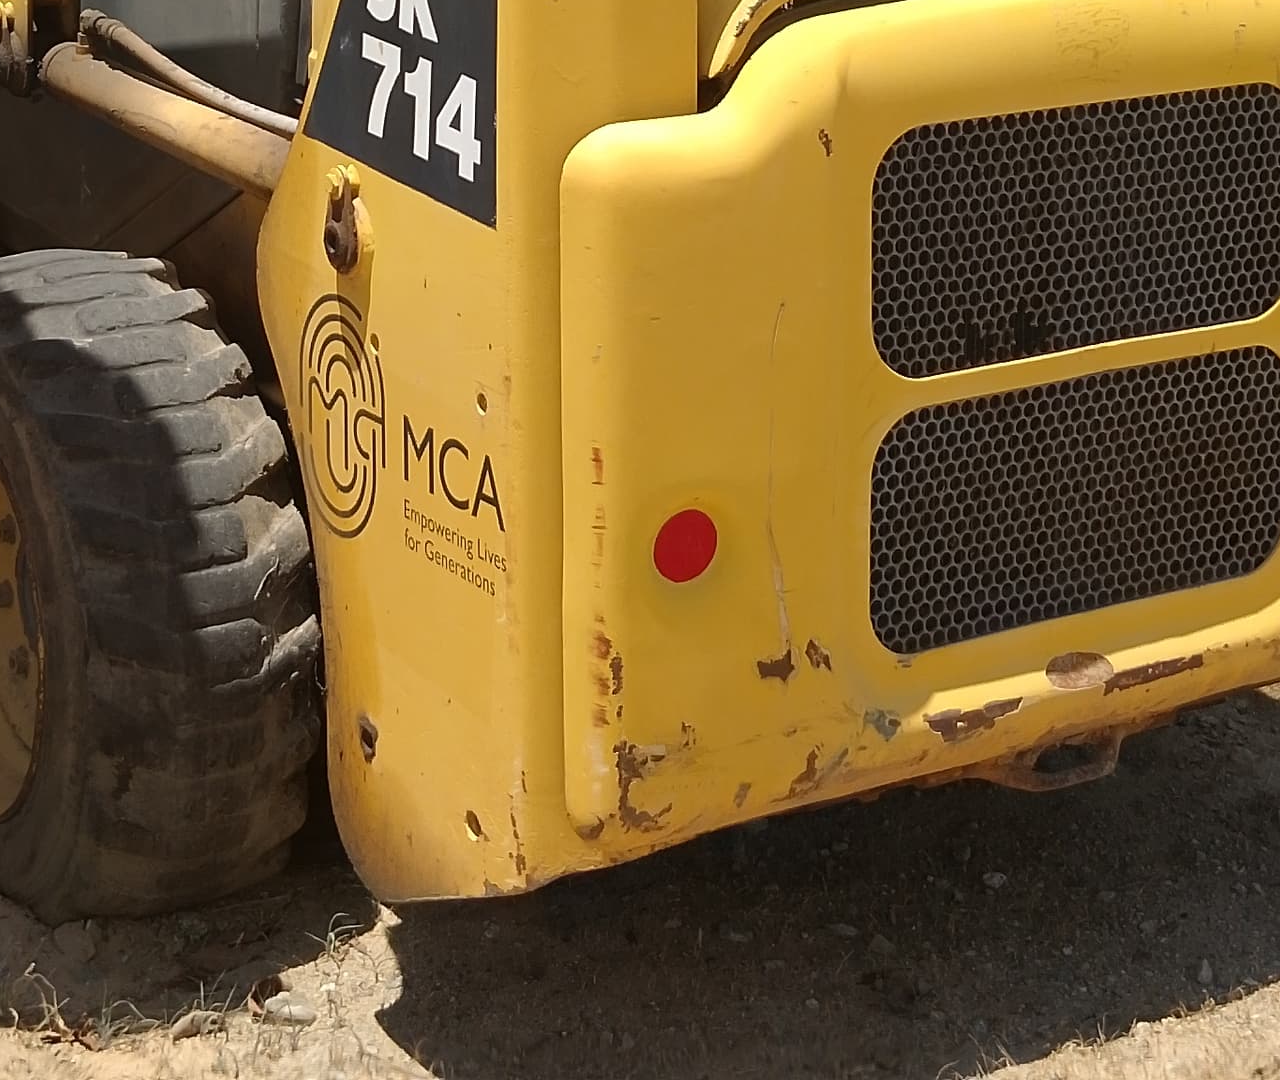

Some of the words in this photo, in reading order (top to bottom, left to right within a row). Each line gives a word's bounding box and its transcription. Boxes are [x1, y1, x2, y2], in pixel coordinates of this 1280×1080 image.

[360, 31, 482, 184] 714
[402, 414, 507, 533] MCA
[402, 498, 474, 560] Empowering
[476, 537, 508, 573] Lives
[403, 527, 422, 555] for
[424, 540, 497, 597] Generations
